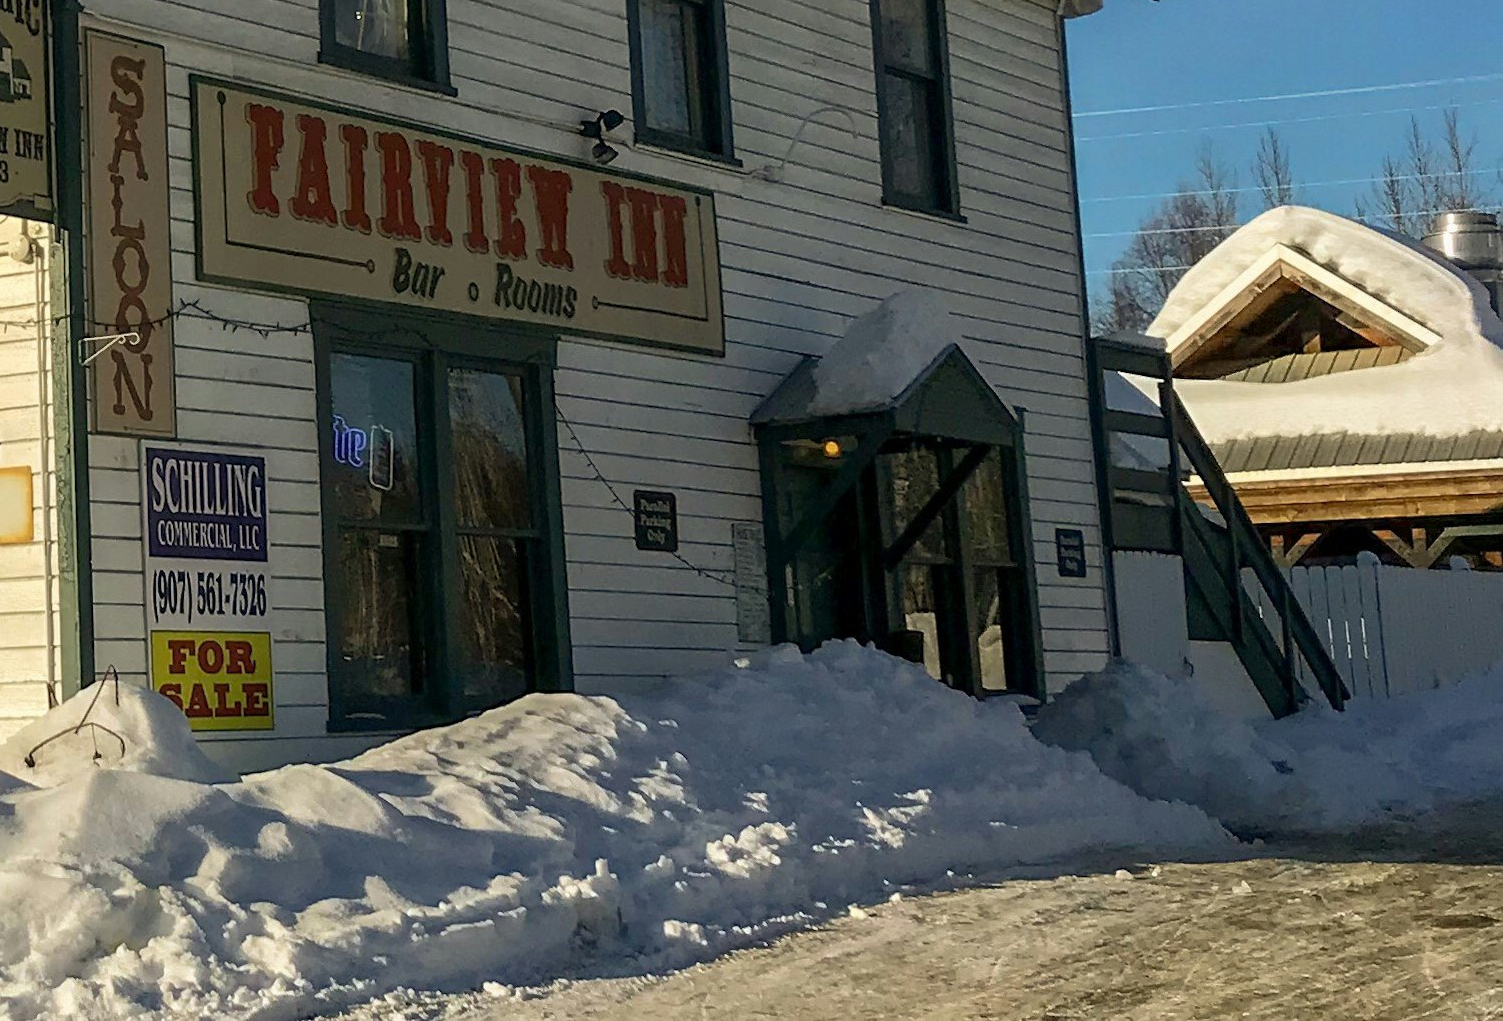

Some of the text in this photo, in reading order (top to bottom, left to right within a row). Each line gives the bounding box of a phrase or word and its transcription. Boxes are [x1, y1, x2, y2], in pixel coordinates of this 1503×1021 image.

[14, 128, 44, 161] INN
[245, 103, 689, 288] FAIRVIEW INN
[108, 55, 153, 421] SALOON
[393, 247, 578, 319] Bar Rooms
[152, 457, 262, 518] SCHILLING
[158, 520, 260, 552] COMMERCIAL, LLC
[153, 569, 267, 624] (907) 561-7326
[168, 640, 256, 674] FOR
